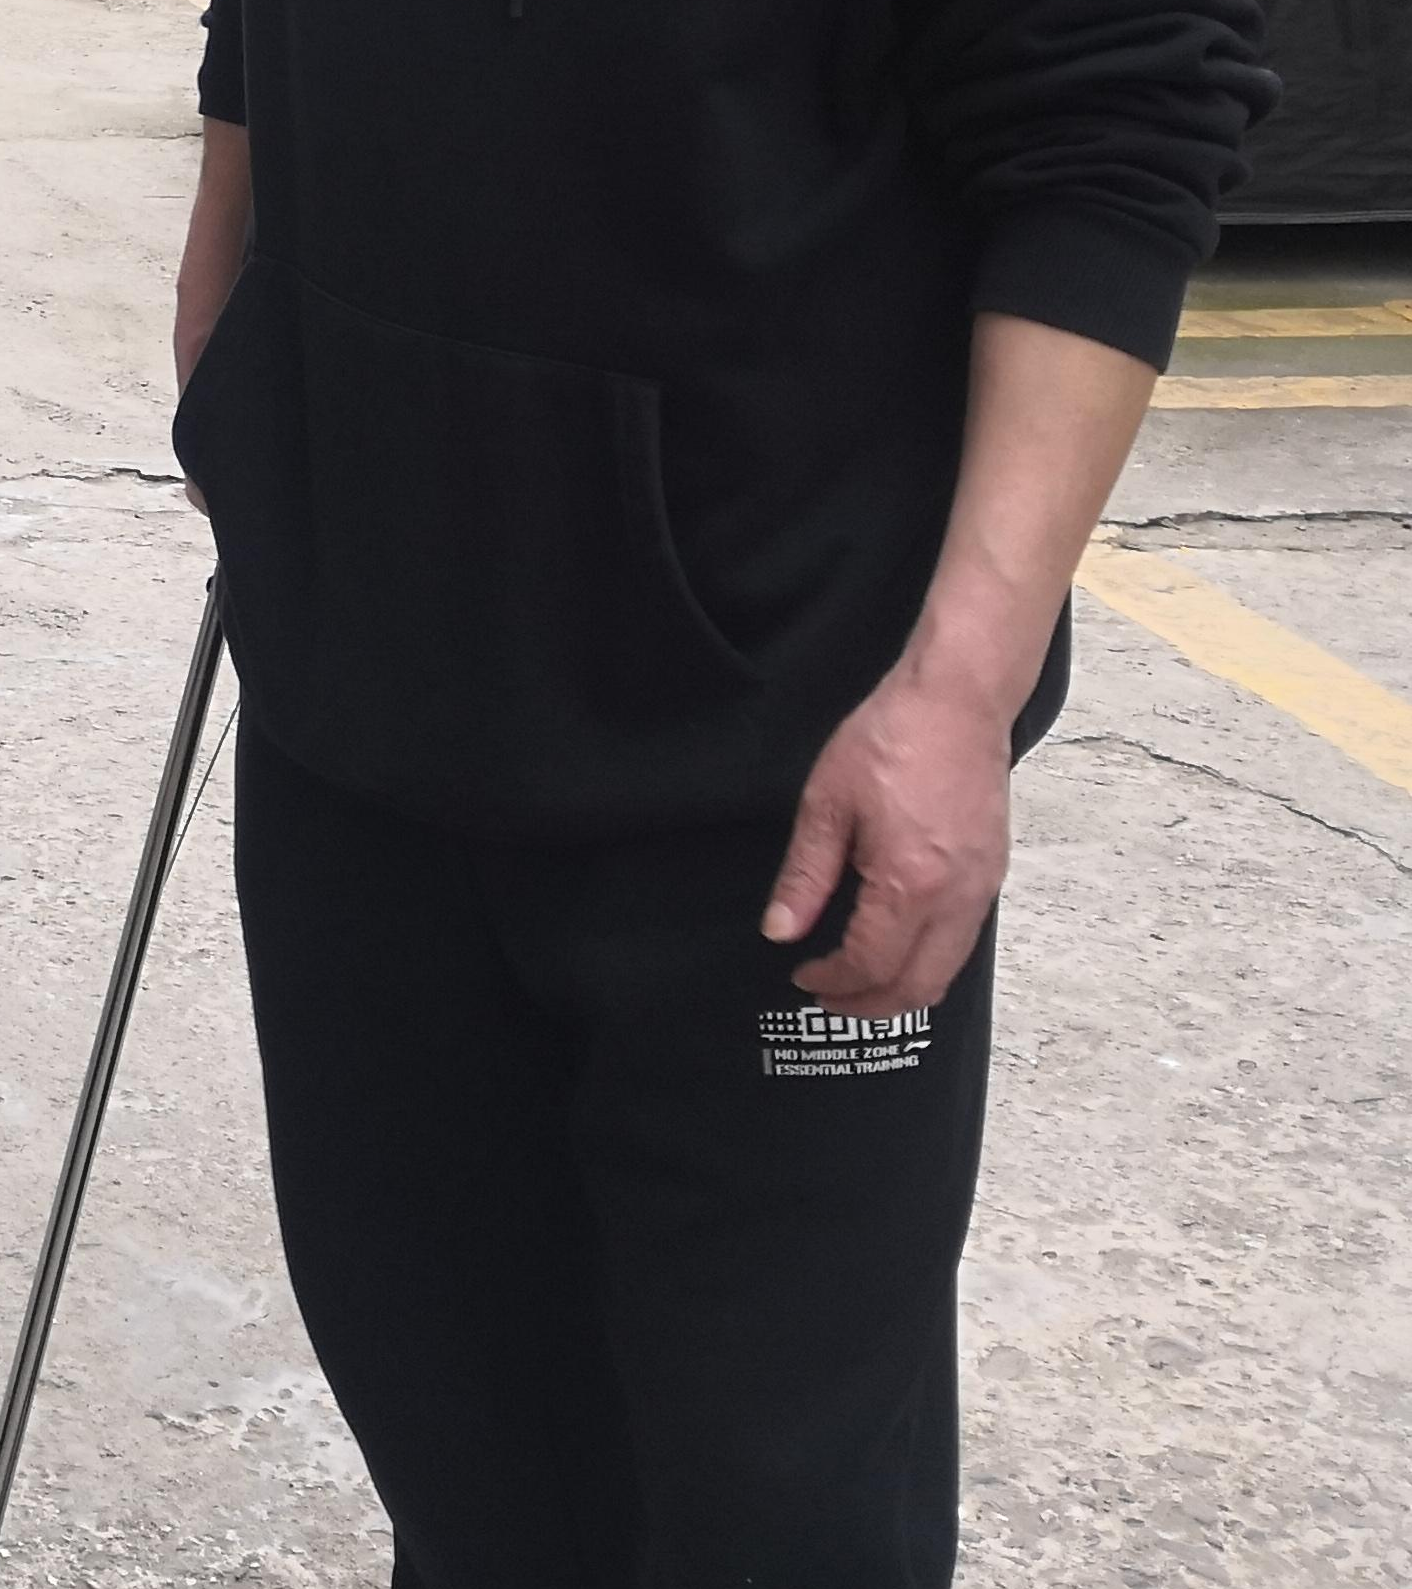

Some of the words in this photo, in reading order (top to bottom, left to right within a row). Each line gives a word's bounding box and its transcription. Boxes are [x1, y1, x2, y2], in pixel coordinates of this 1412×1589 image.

[775, 1049, 798, 1061] NO
[801, 1048, 860, 1061] MIDDLE
[863, 1044, 901, 1060] ZONE
[776, 1063, 854, 1076] ESSENTIAL
[854, 1055, 920, 1075] TRAINING
